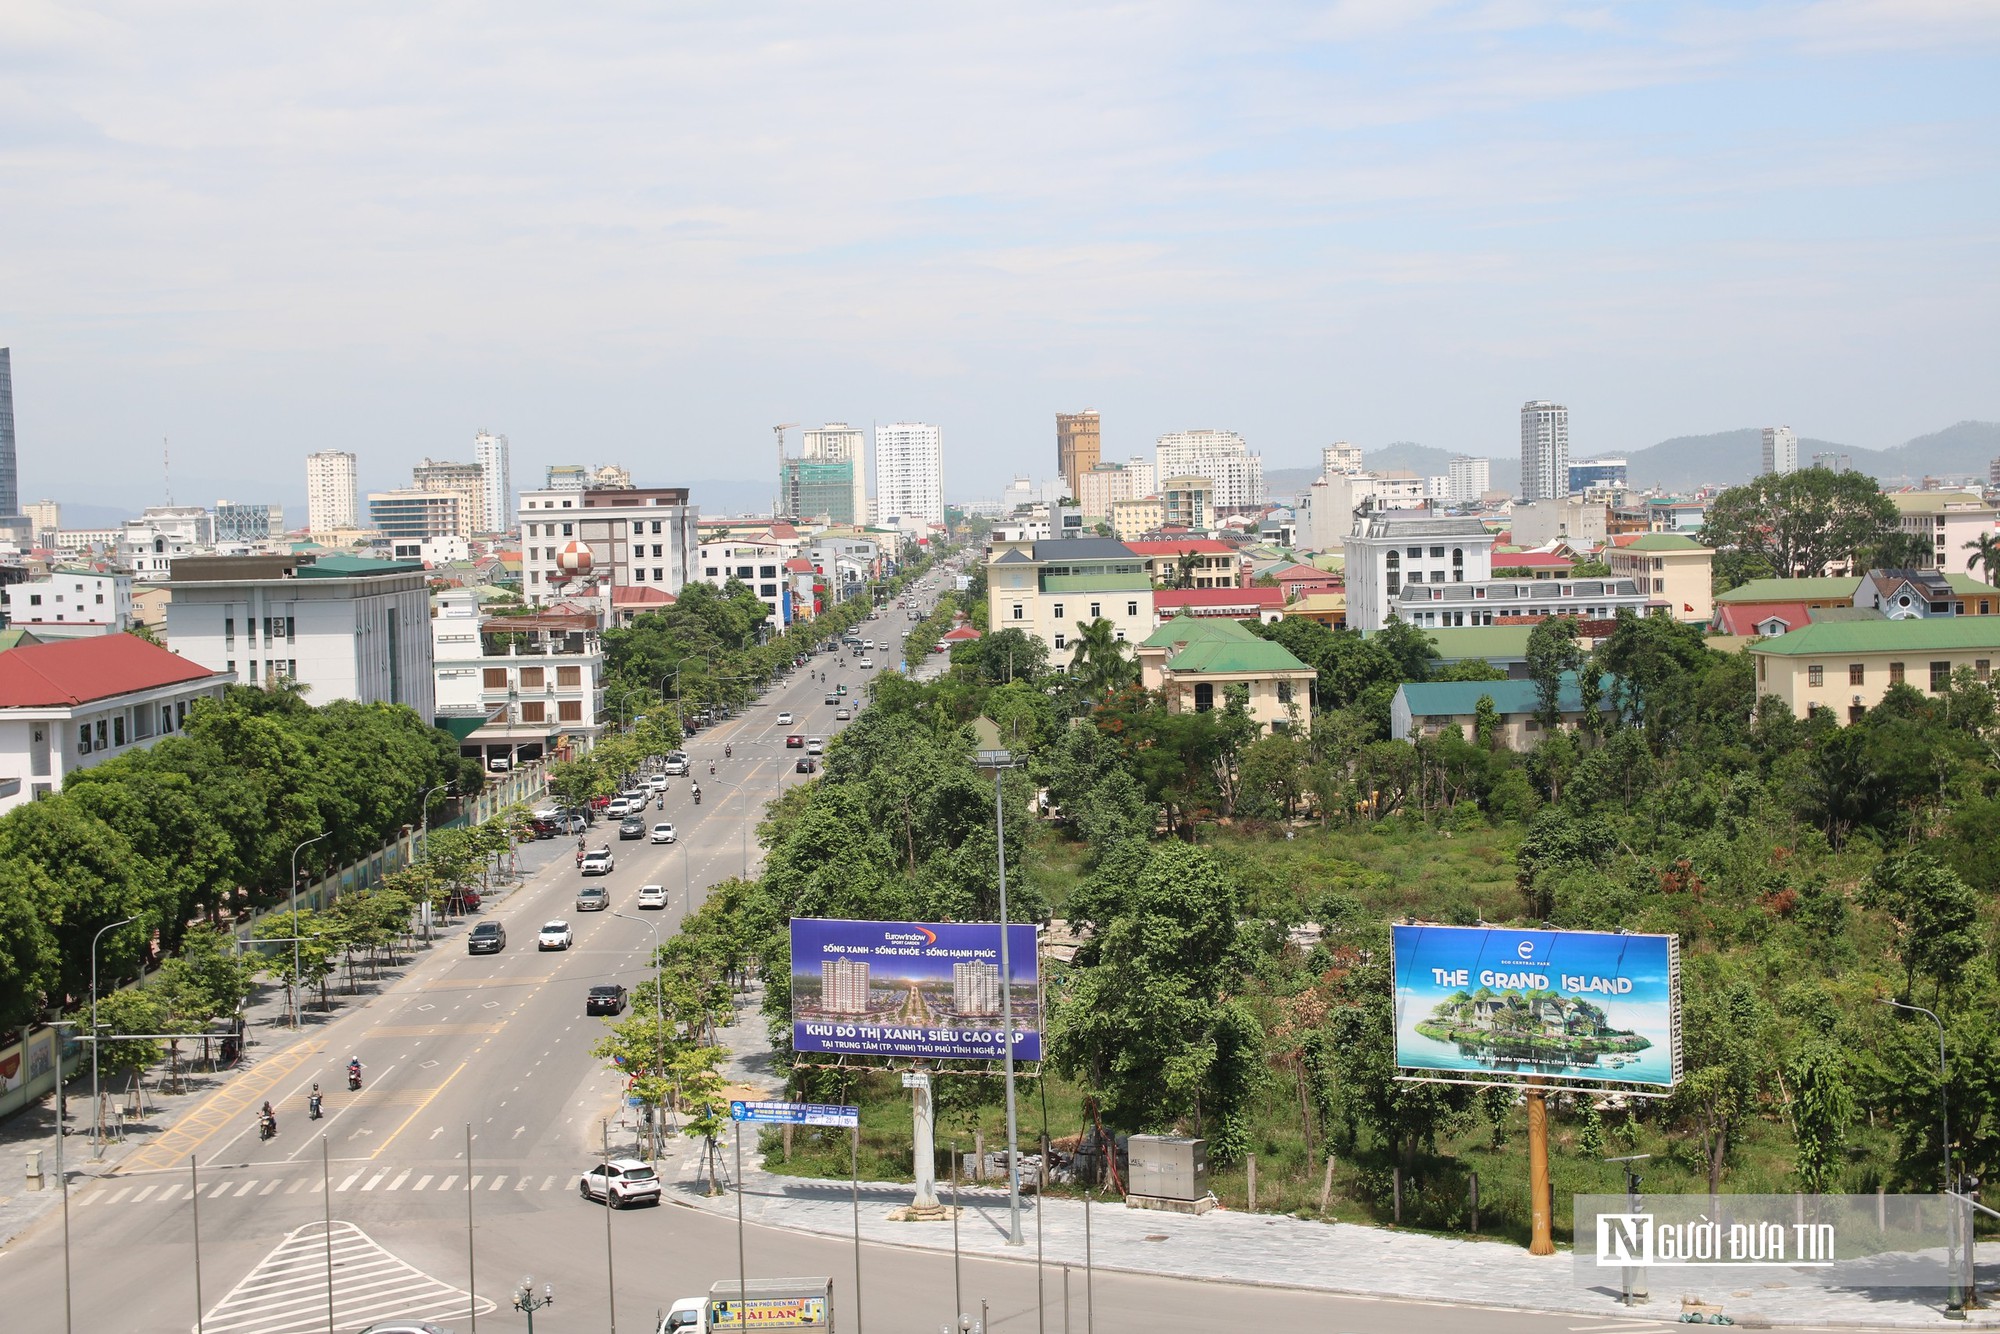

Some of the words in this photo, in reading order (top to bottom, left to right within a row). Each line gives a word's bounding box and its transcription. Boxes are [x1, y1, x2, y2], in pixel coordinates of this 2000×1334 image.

[885, 932, 926, 941] Eurowindow
[823, 943, 846, 953] SỐNG
[846, 945, 869, 954] XANH
[875, 945, 897, 955] SỐNG
[898, 947, 920, 956] KHỎE
[926, 947, 949, 957] SỐNG
[950, 949, 973, 959] HẠNH
[974, 948, 997, 958] PHÚC
[1432, 968, 1469, 987] THE
[1479, 970, 1549, 990] GRAND
[1561, 974, 1632, 995] ISLAND
[806, 1024, 833, 1036] KHU
[836, 1024, 856, 1038] ĐÔ
[859, 1027, 881, 1041] THỊ
[884, 1028, 926, 1042] XANH,
[928, 1028, 959, 1042] SIÊU
[962, 1031, 992, 1043] CAO
[821, 1040, 834, 1050] TẠI
[835, 1041, 861, 1049] TRUNG
[861, 1041, 878, 1050] TÂM
[880, 1043, 893, 1051] (TP.
[894, 1044, 916, 1052] VINH)
[917, 1043, 933, 1052] THỦ
[935, 1043, 951, 1053] PHỦ
[953, 1045, 971, 1054] TỈNH
[972, 1046, 995, 1057] NGHỆ
[767, 1310, 797, 1319] LAN
